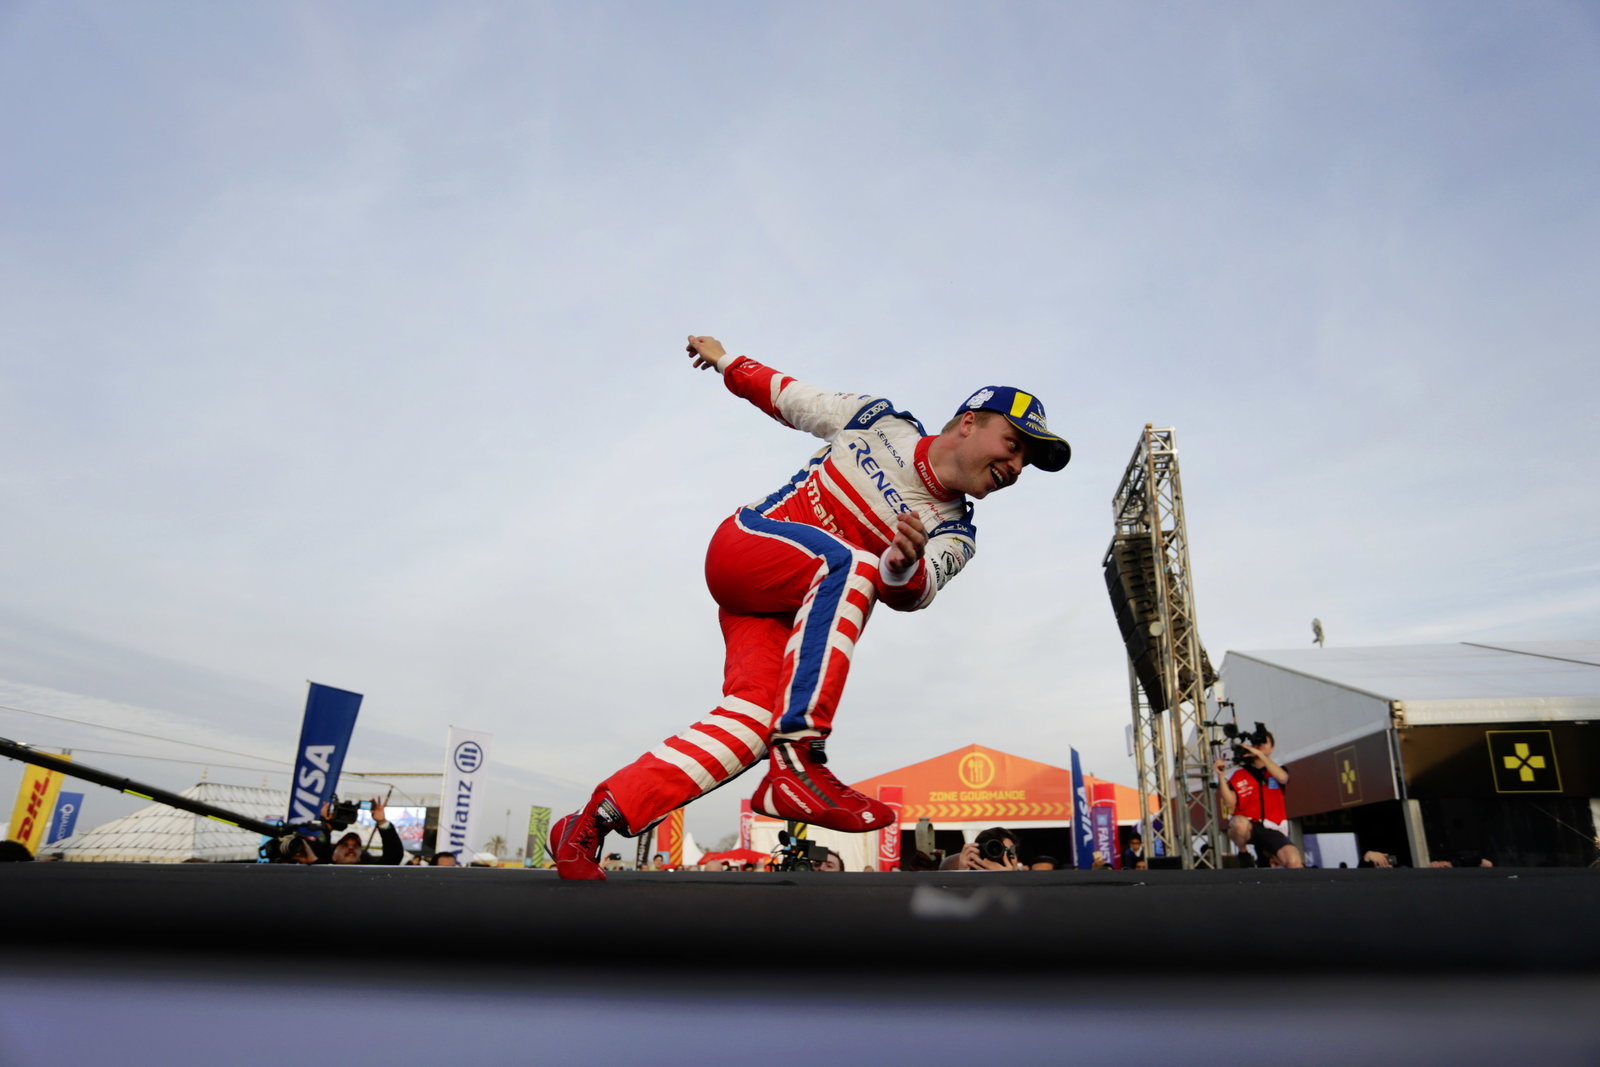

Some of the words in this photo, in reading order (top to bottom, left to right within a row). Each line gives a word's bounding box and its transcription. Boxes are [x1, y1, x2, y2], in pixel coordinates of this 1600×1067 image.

[849, 436, 913, 516] RENES
[874, 428, 906, 469] RENESAS
[16, 776, 50, 842] DHL
[289, 744, 336, 825] VISA
[929, 791, 958, 802] ZONE
[960, 790, 1026, 801] GOURMANDE
[57, 803, 75, 841] QUALCO
[449, 779, 473, 866] Allianz
[1077, 786, 1093, 848] VISA
